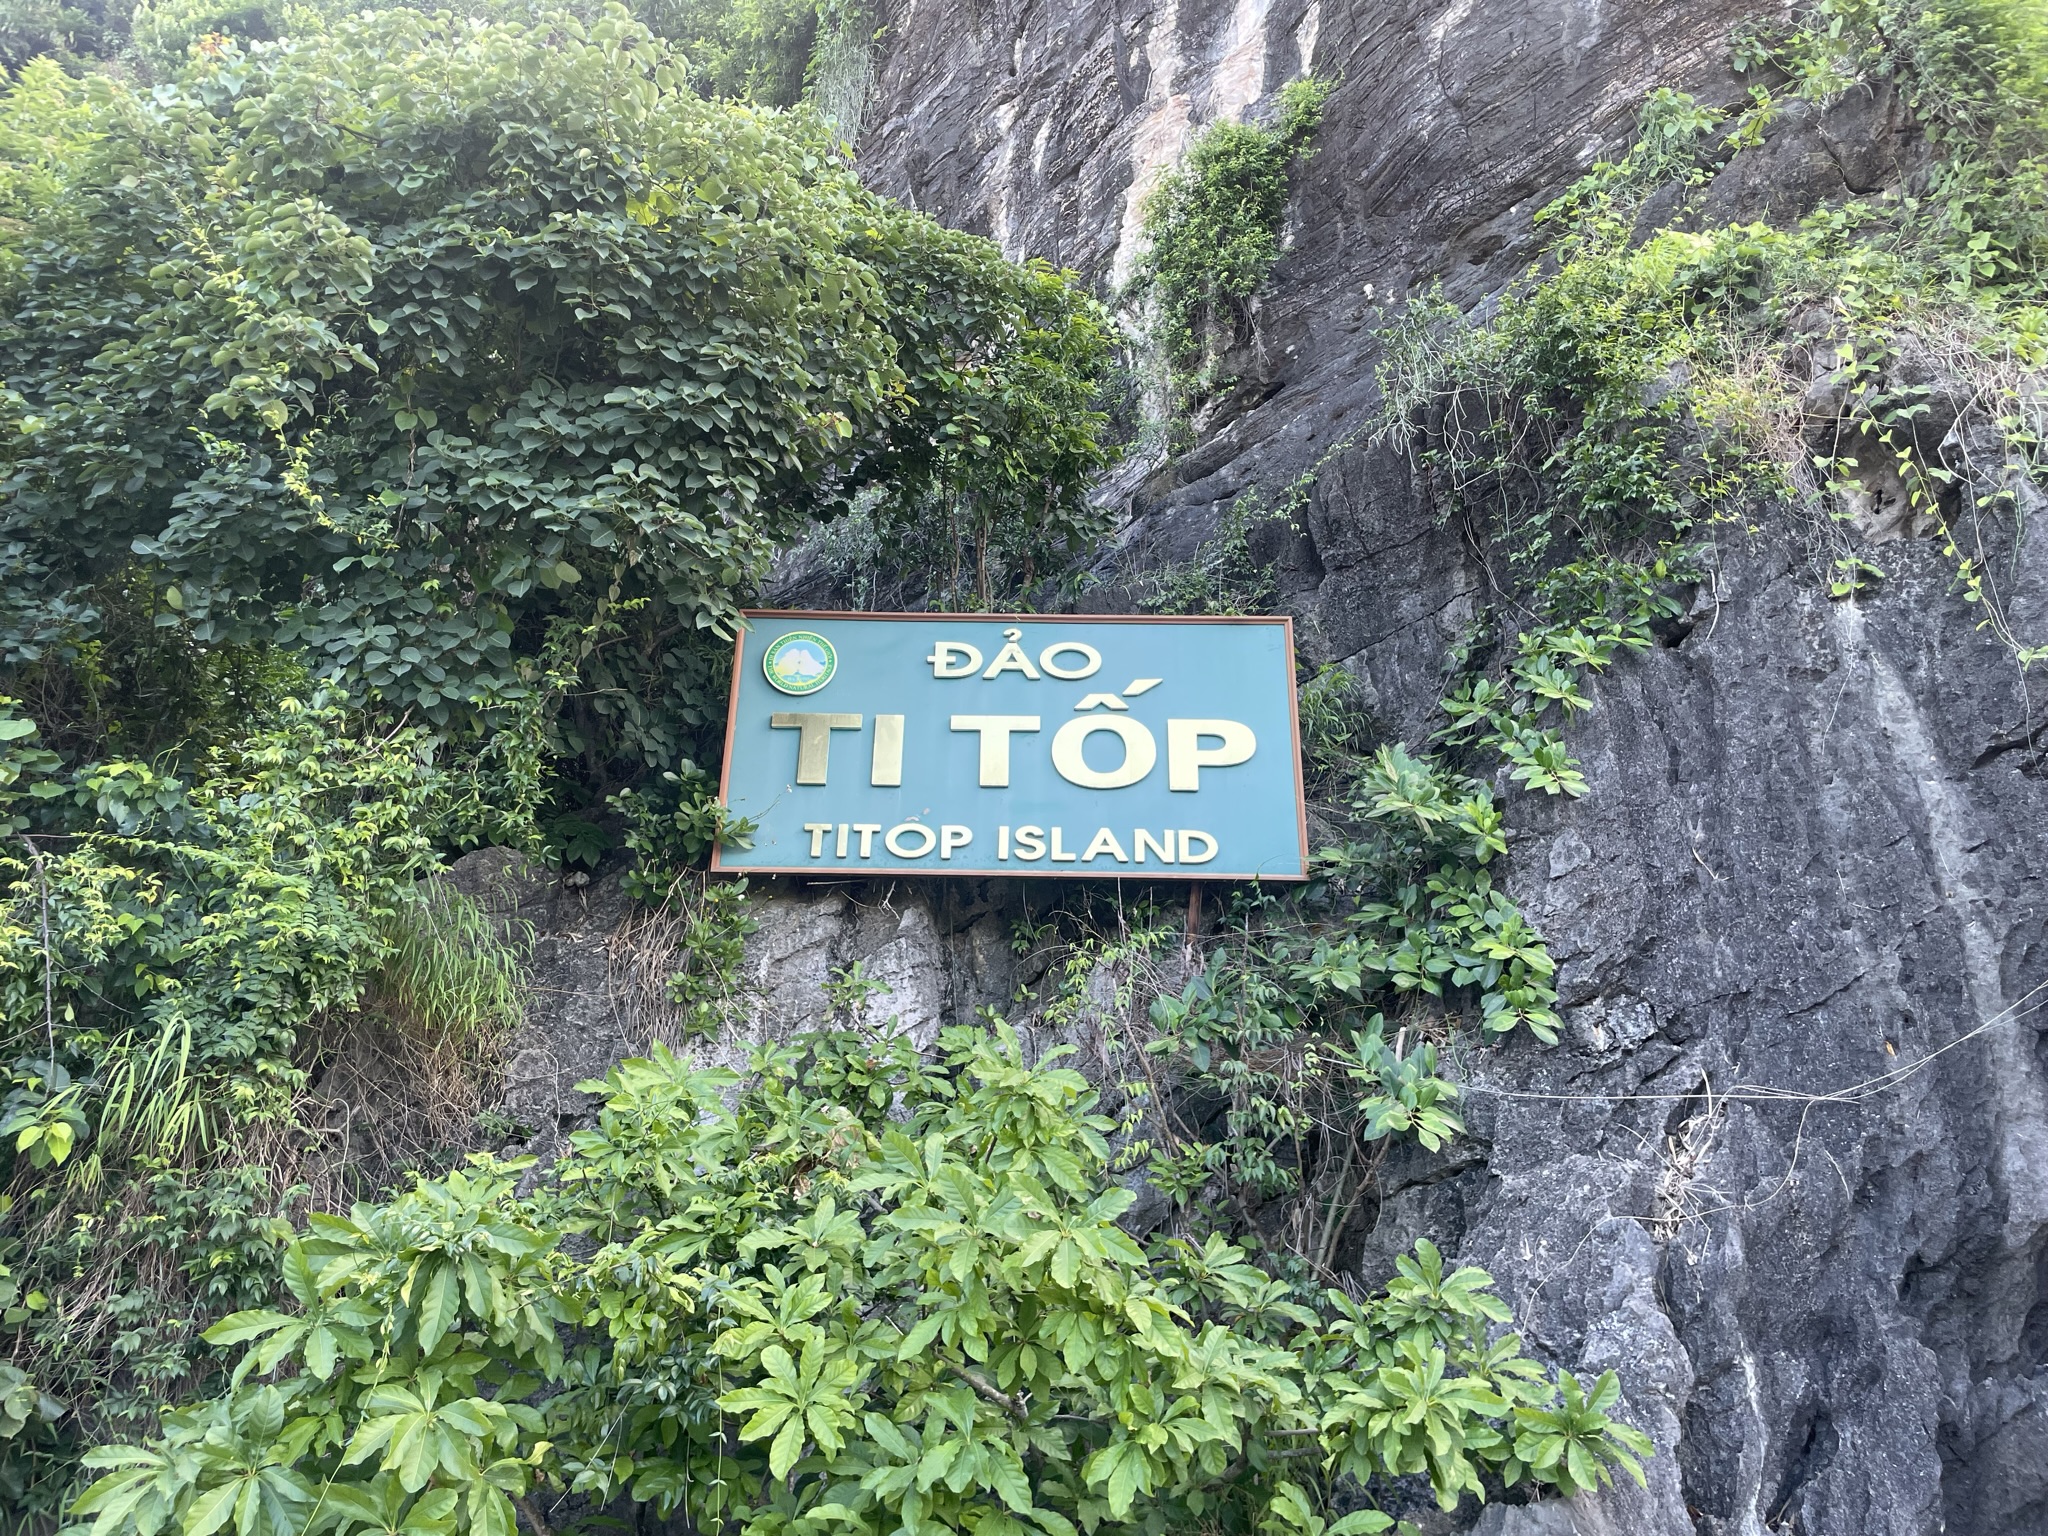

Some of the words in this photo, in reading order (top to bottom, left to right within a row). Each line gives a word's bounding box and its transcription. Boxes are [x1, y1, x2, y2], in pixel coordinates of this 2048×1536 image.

[927, 628, 1103, 681] ĐẢO
[771, 712, 904, 788] TI
[949, 677, 1258, 792] TỐP
[998, 825, 1219, 866] ISLAND
